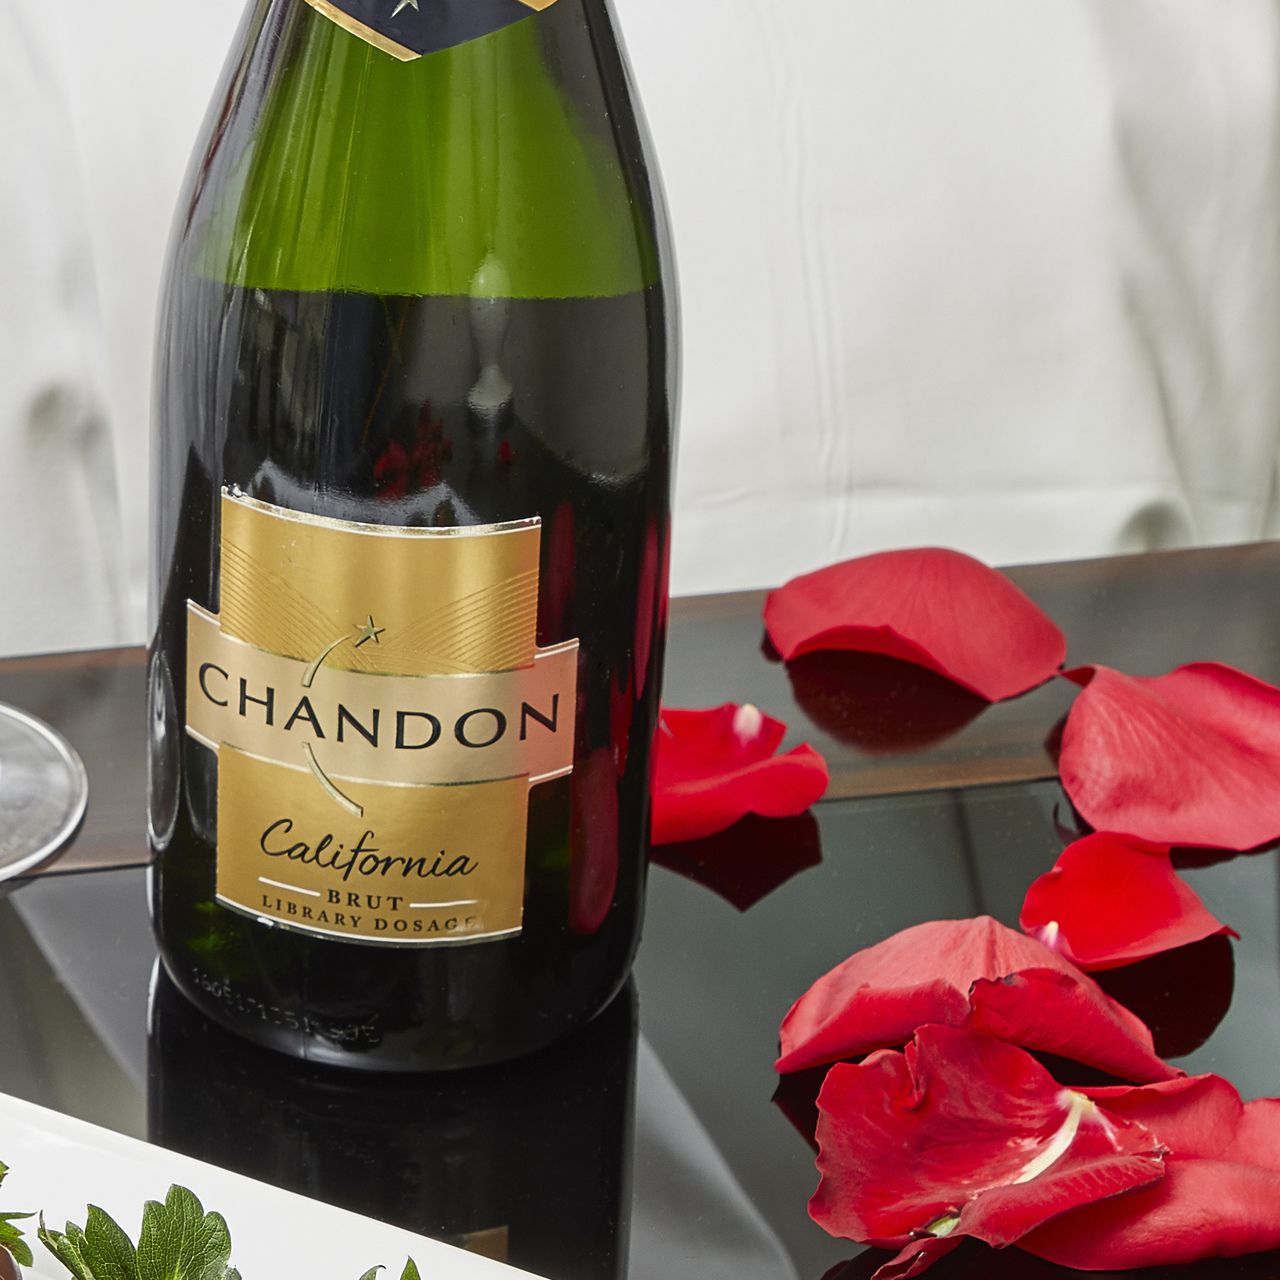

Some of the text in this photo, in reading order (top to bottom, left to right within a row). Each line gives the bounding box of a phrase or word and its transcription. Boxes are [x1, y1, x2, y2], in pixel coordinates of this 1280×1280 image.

[198, 662, 559, 750] CHANDON
[259, 818, 480, 882] California
[262, 895, 363, 928] LIBRARY
[327, 888, 404, 911] BRUT
